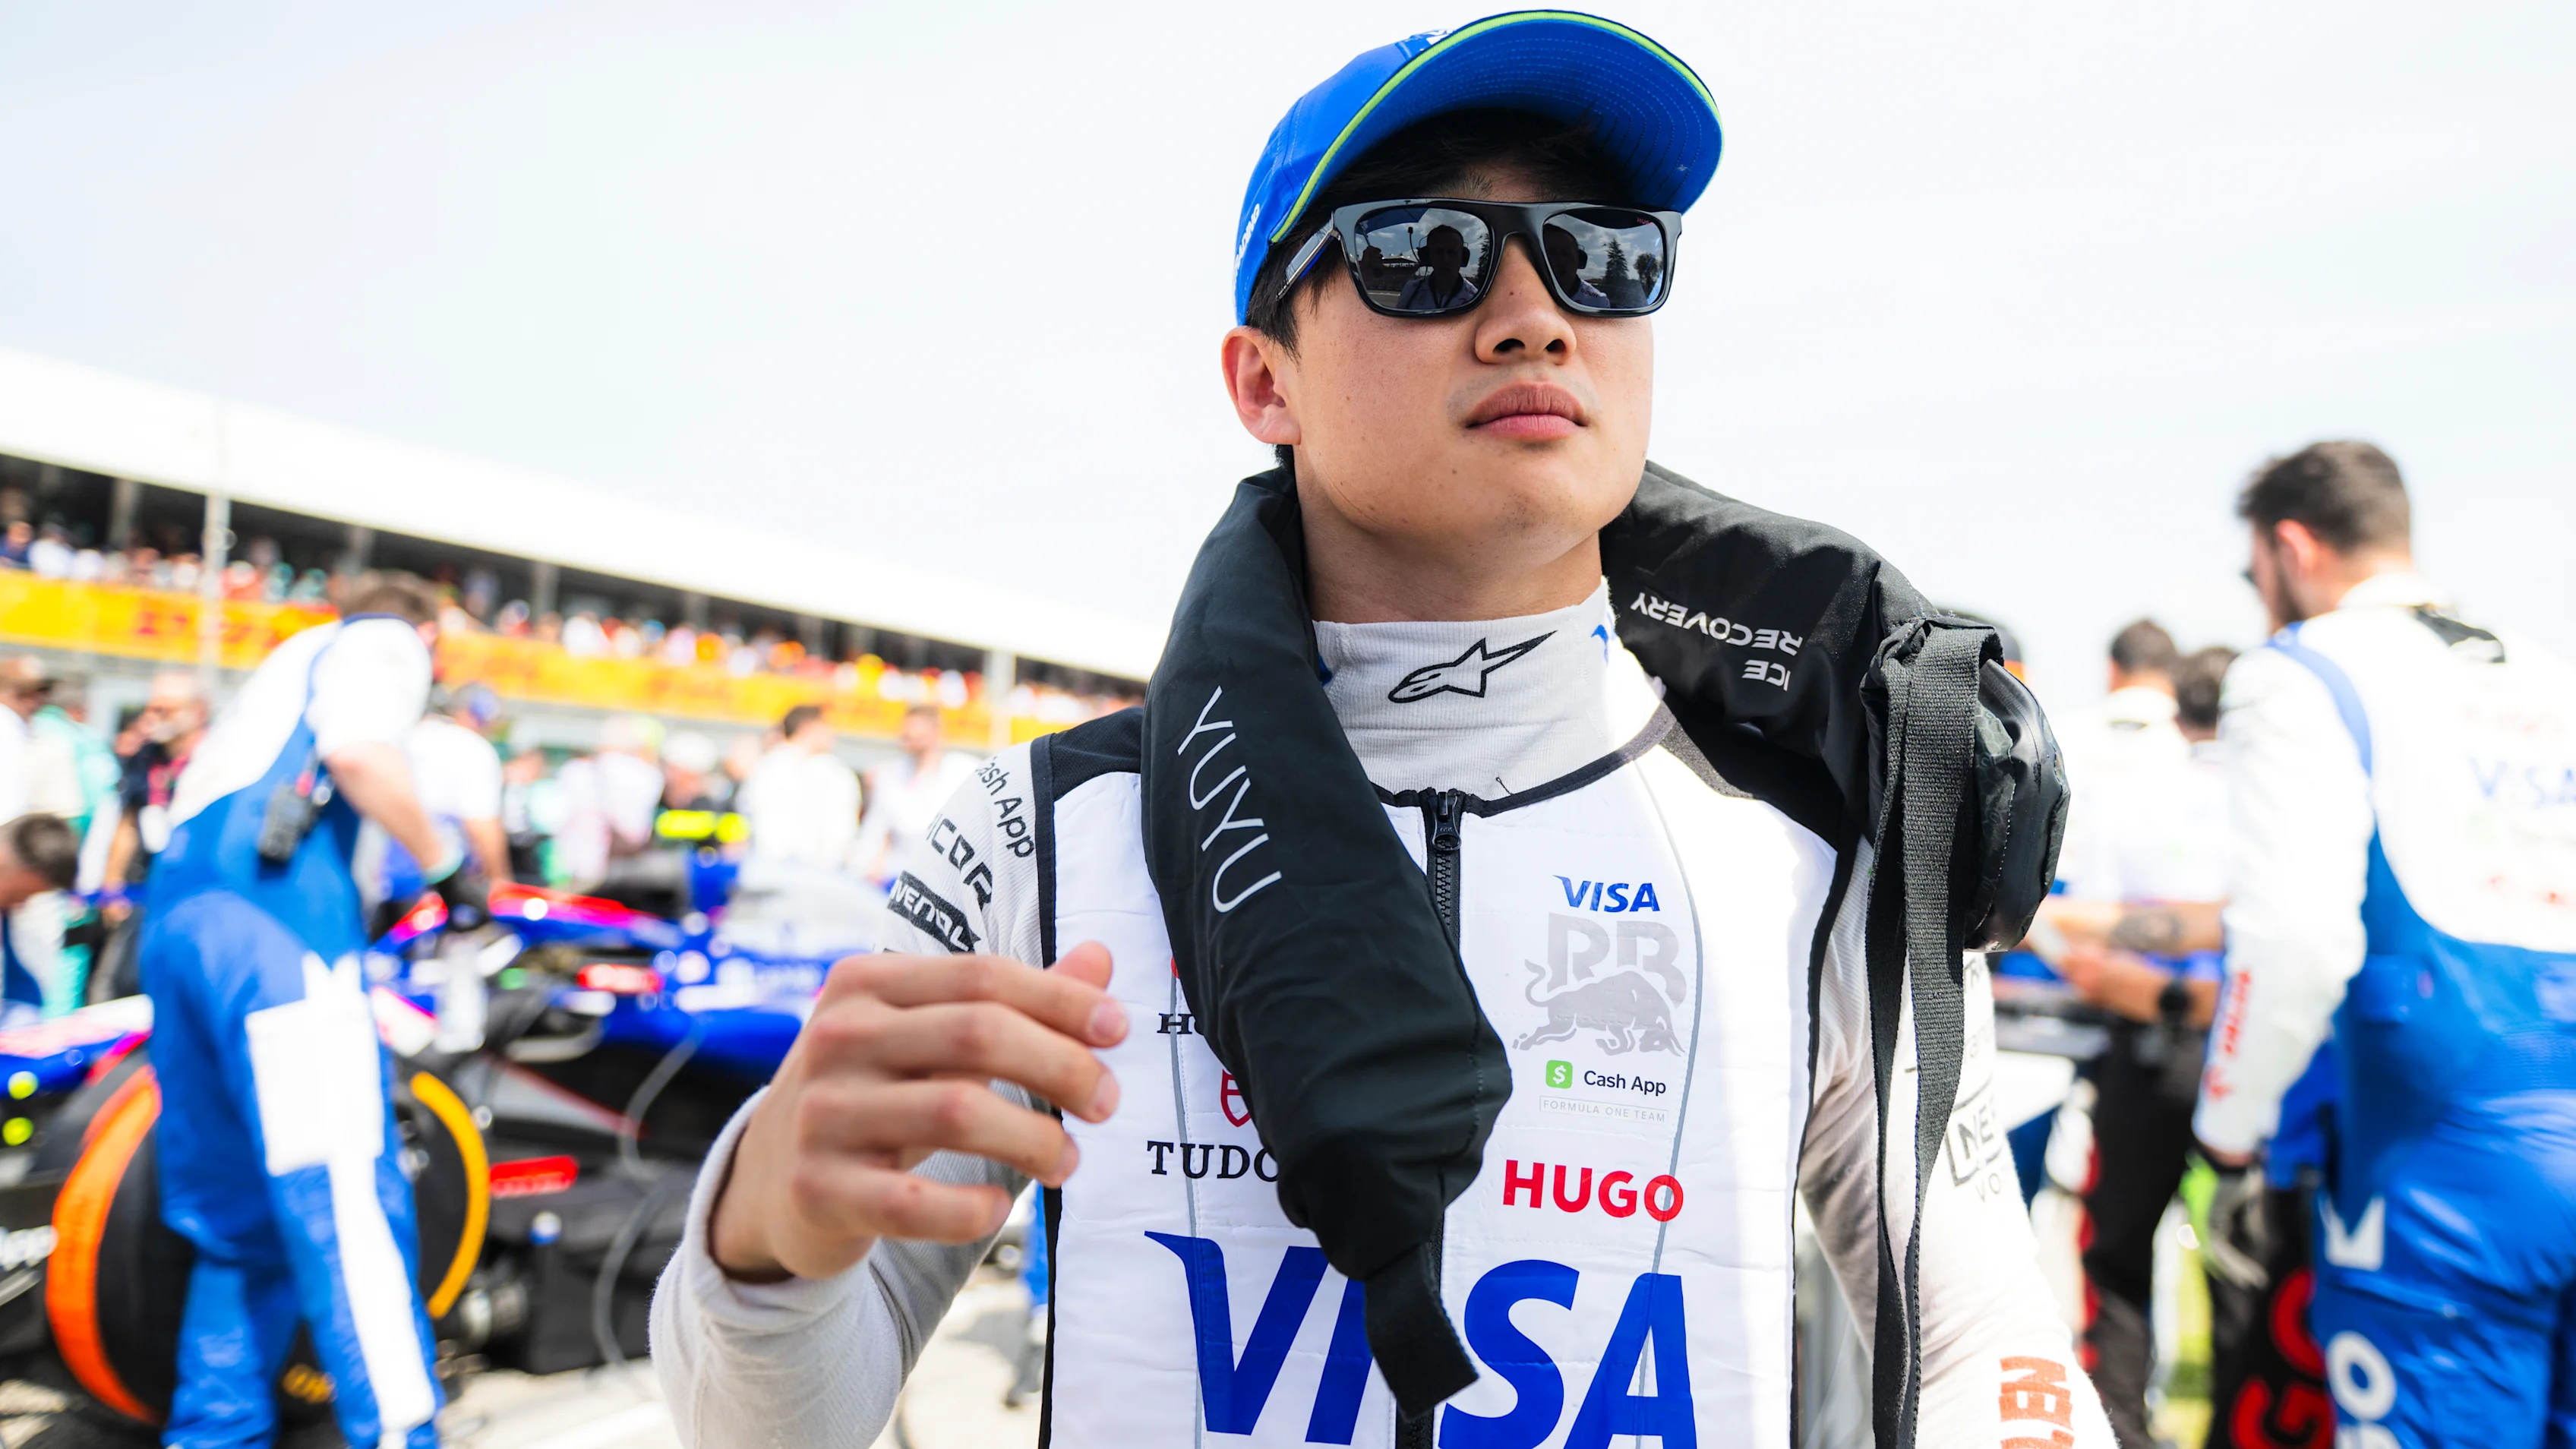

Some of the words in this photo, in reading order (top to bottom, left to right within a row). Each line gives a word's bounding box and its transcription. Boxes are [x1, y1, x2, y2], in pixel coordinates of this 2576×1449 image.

[1630, 592, 1803, 656] RECOVERY
[1741, 659, 1791, 691] ICE
[975, 756, 1010, 796] ash
[994, 797, 1034, 858] App
[1177, 685, 1282, 913] YUYU
[1552, 874, 1660, 912] VISA
[1583, 1070, 1626, 1089] Cash
[1631, 1076, 1666, 1096] App
[1543, 1100, 1599, 1114] FORMULA
[1605, 1107, 1629, 1117] ONE
[1635, 1110, 1665, 1122] TEAM
[1147, 1141, 1278, 1182] TUDO
[1503, 1160, 1684, 1222] HUGO
[1144, 1230, 1697, 1449] VISA
